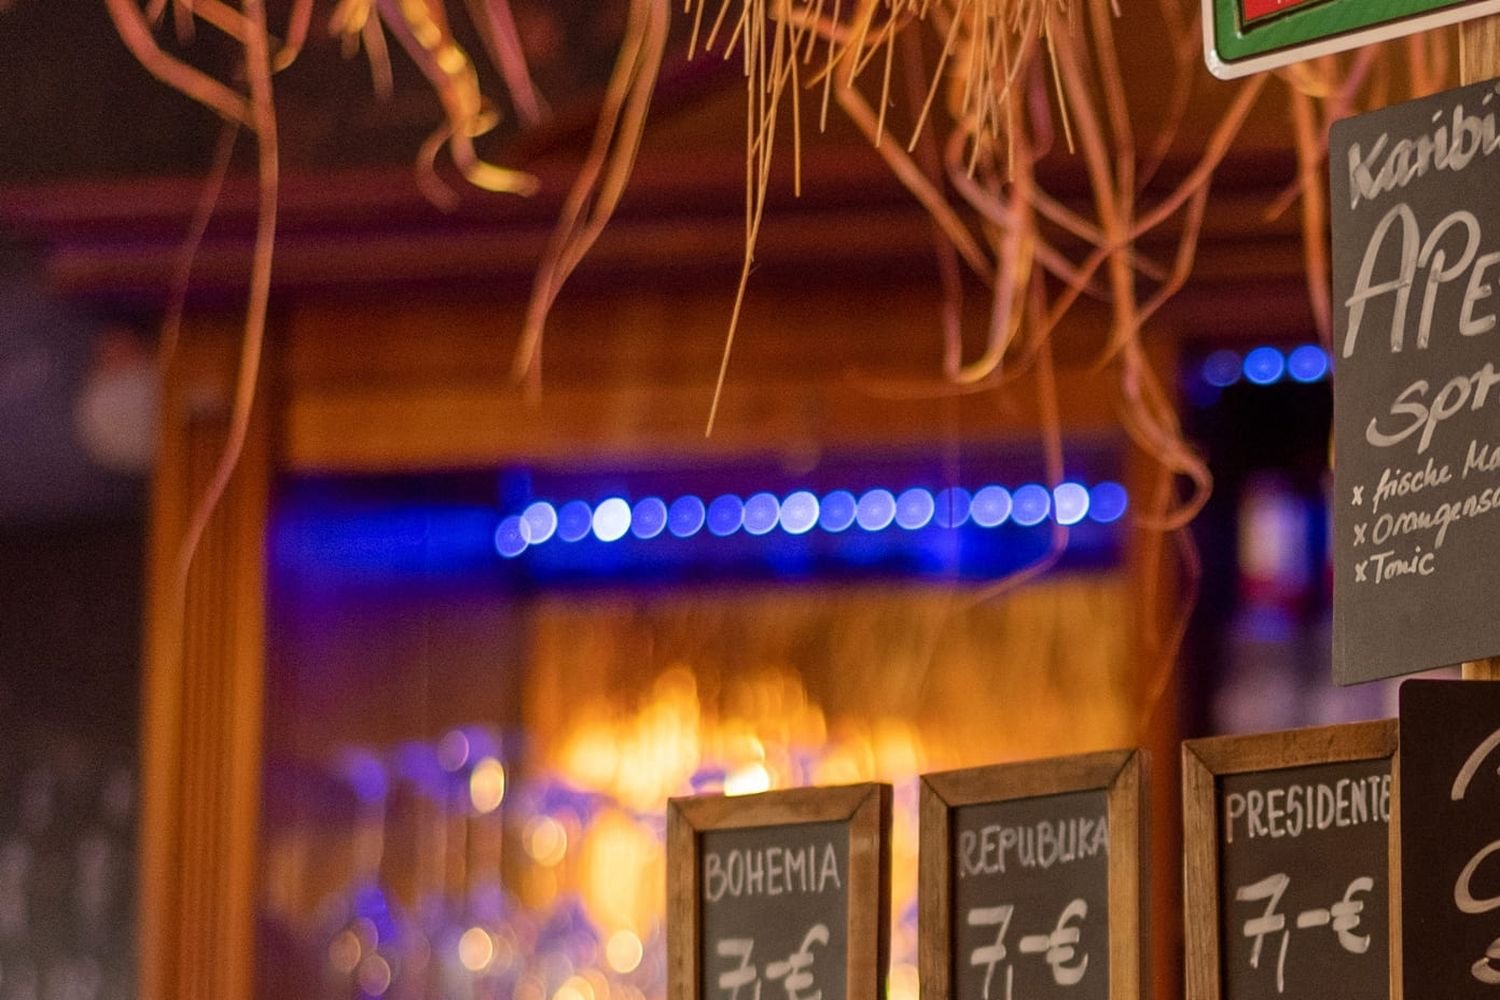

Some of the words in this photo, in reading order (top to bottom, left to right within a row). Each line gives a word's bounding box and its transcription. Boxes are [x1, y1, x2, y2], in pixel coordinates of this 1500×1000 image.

[1373, 457, 1452, 515] frische
[1370, 545, 1436, 585] Tonic
[1226, 774, 1392, 844] PRESIDENTE
[705, 842, 842, 902] BOHEMIA
